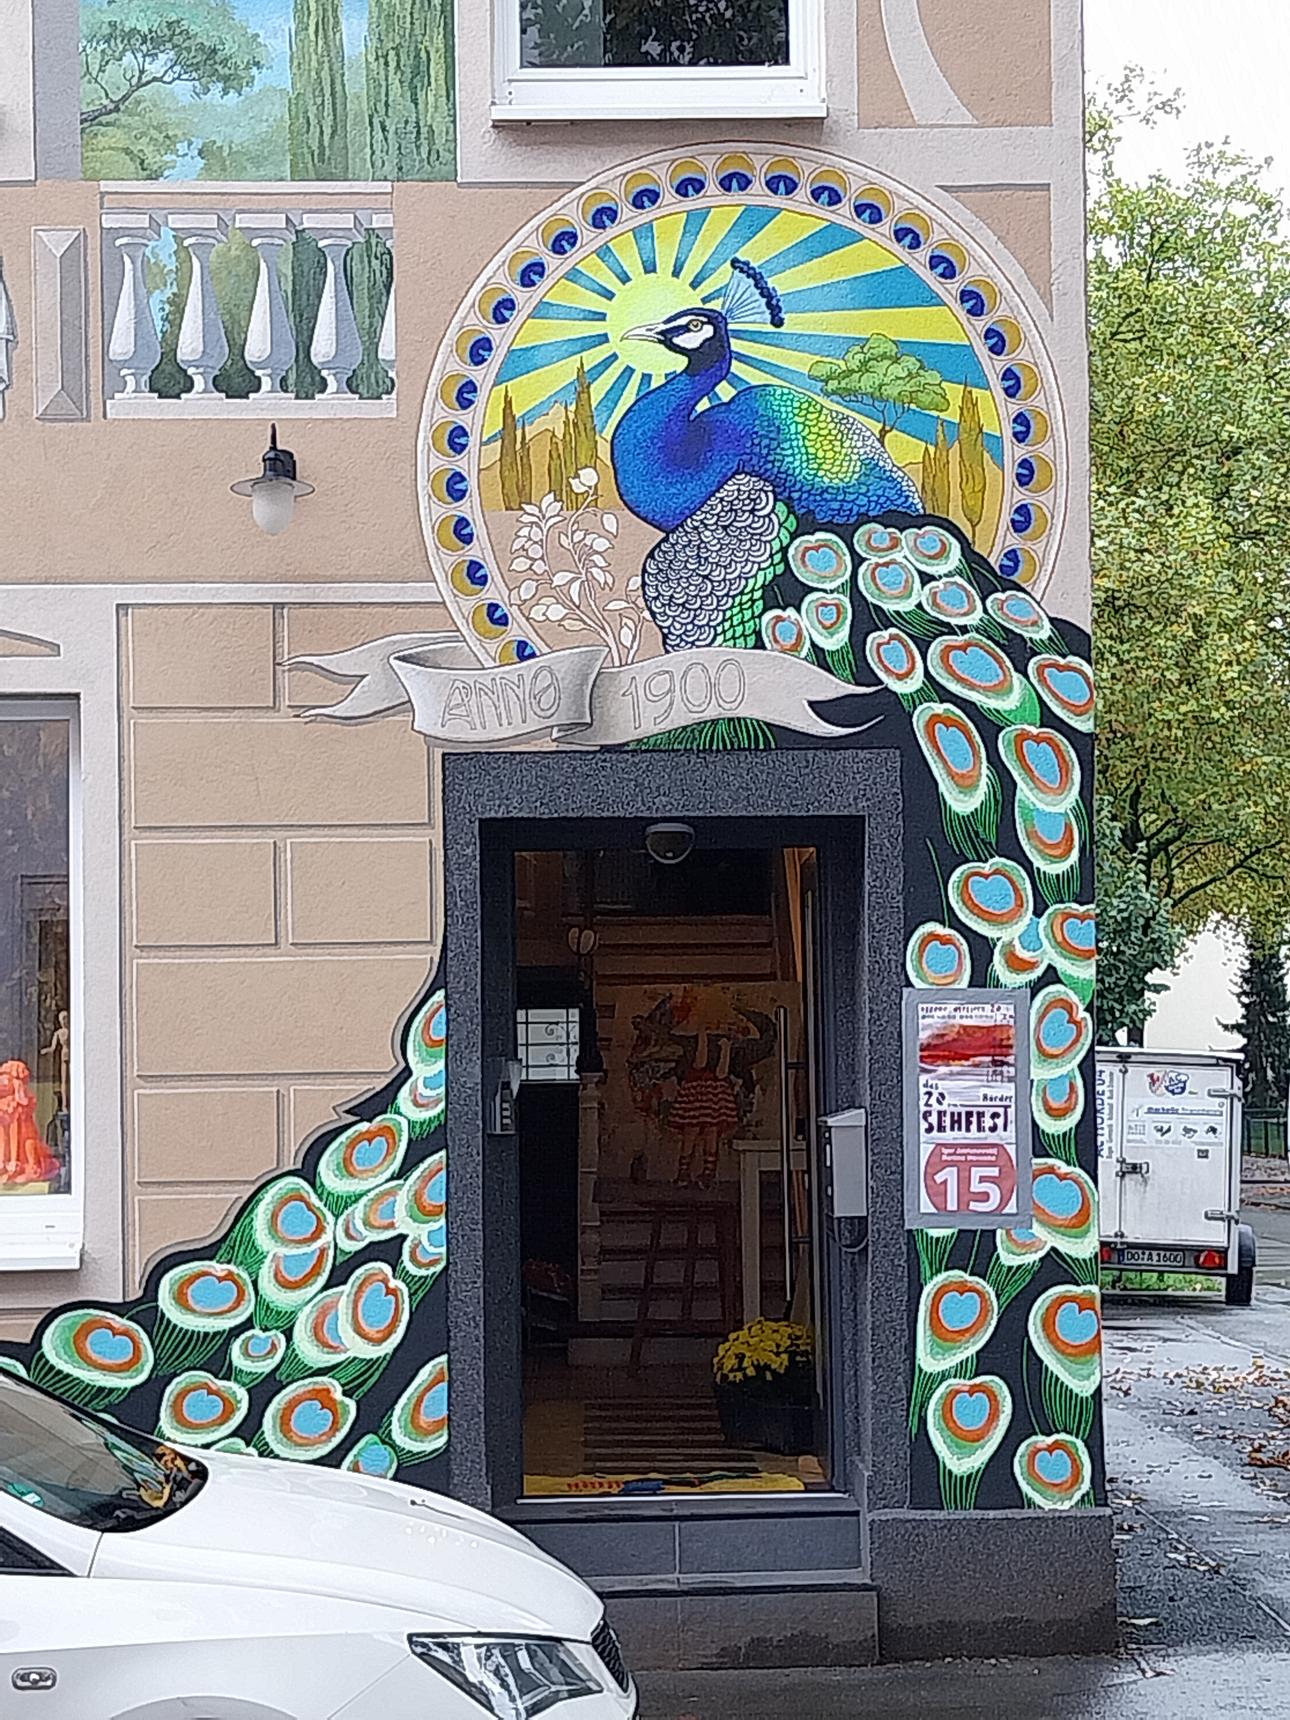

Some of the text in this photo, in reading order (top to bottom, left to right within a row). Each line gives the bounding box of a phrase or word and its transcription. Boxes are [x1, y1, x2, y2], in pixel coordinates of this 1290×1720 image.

[440, 657, 746, 730] ANNO 1900
[922, 1104, 1012, 1134] SEHFEST
[933, 1166, 1001, 1212] 15
